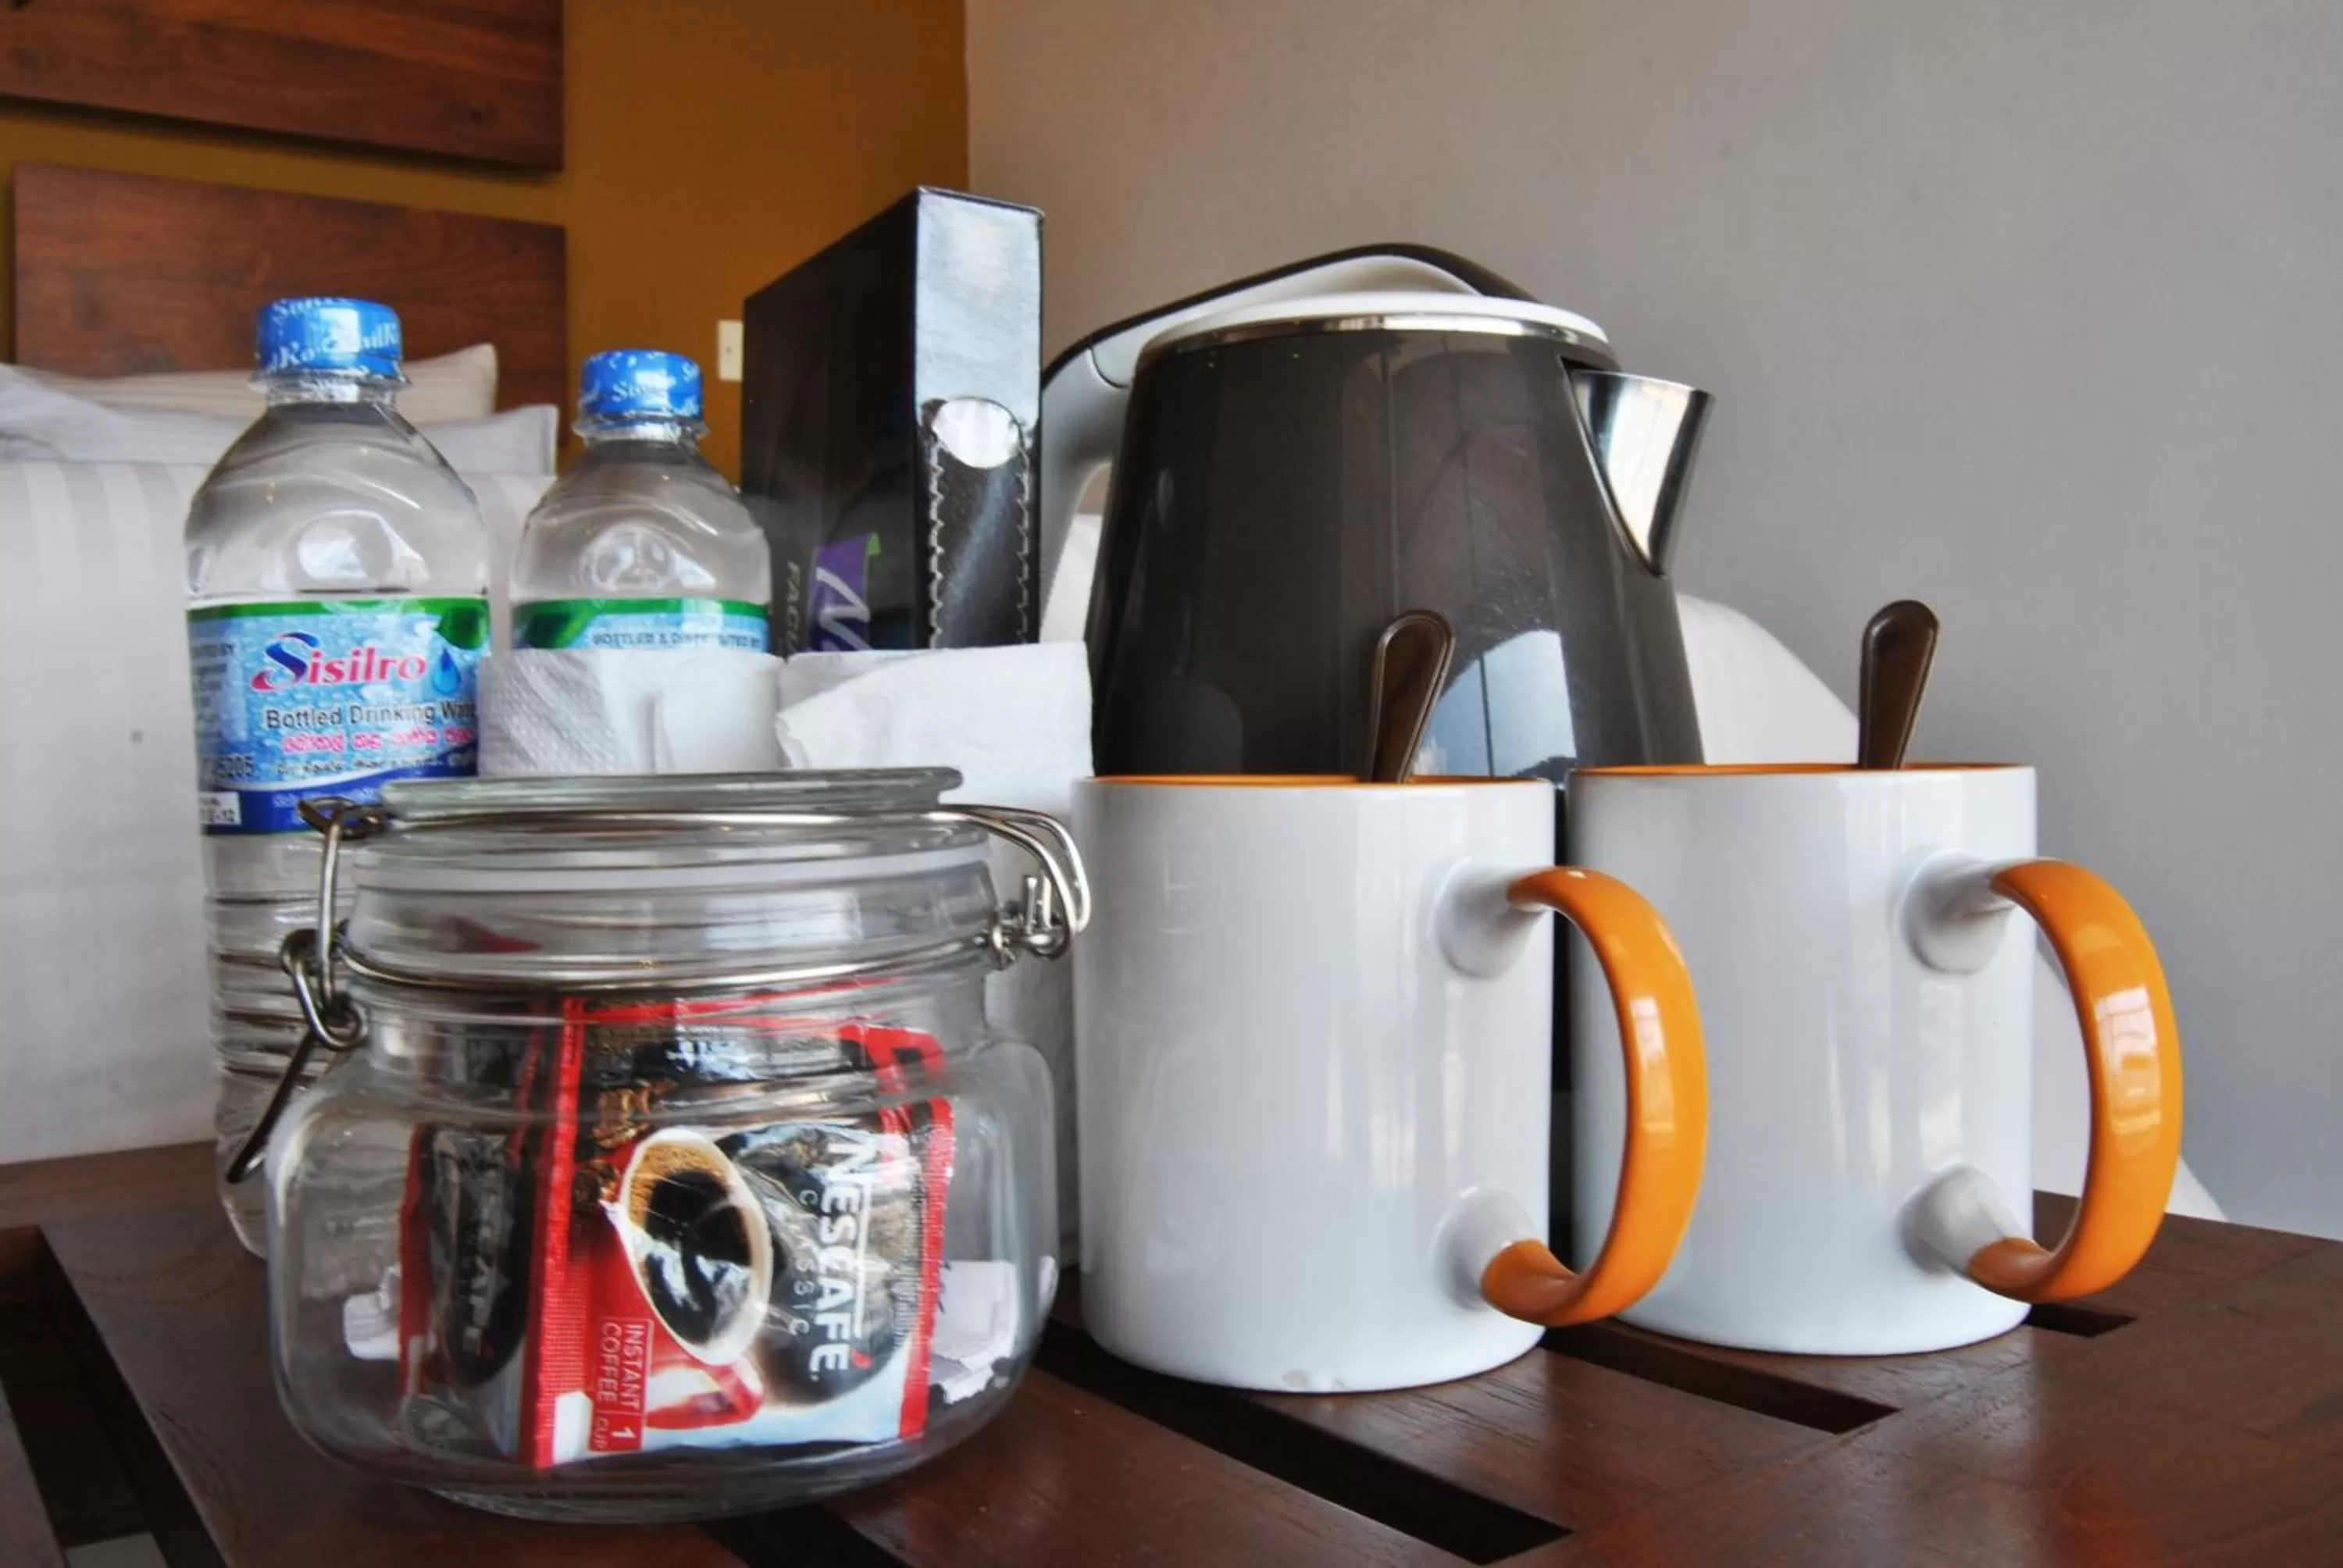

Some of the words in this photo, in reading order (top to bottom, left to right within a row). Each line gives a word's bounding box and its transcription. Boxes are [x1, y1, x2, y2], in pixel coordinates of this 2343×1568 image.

[251, 632, 427, 692] Sisilro
[266, 707, 342, 729] Bottled
[349, 704, 436, 725] Drinking
[596, 1322, 622, 1402] COFFEE
[619, 1324, 645, 1410] INSTANT
[594, 1417, 609, 1449] CUP
